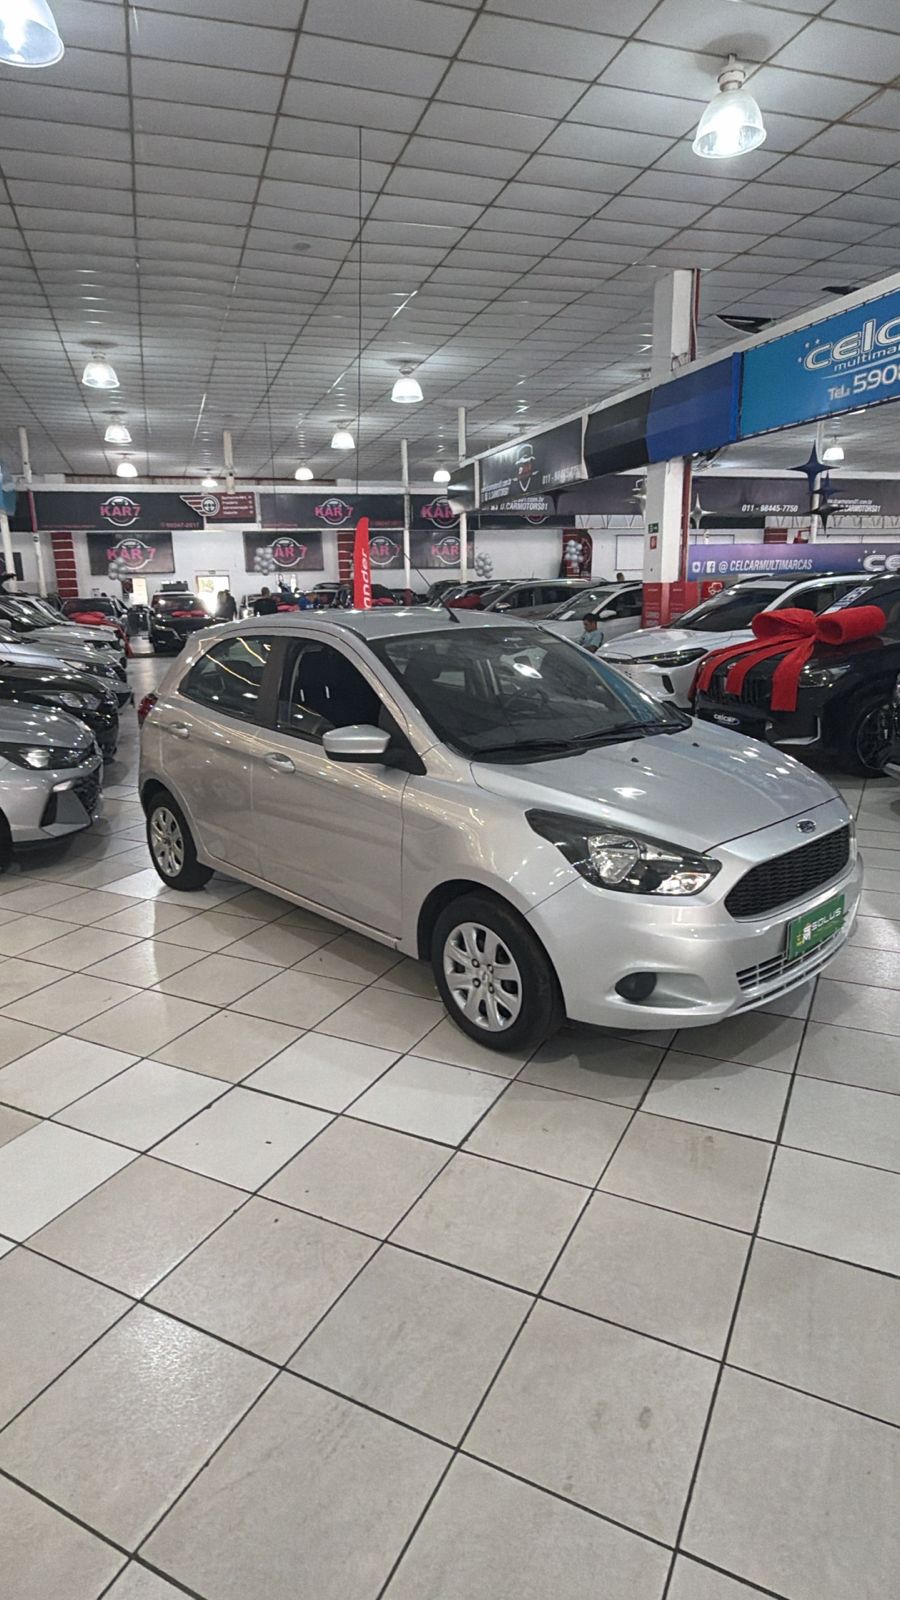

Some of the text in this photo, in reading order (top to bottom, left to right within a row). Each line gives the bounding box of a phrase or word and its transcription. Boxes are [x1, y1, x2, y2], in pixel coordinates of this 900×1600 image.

[833, 345, 900, 371] multima
[853, 364, 900, 394] 590
[741, 504, 754, 512] 011
[273, 546, 295, 558] AR
[370, 545, 390, 556] AR
[730, 558, 813, 572] CELCARMULTIMARCAS
[811, 907, 842, 931] SOLUS
